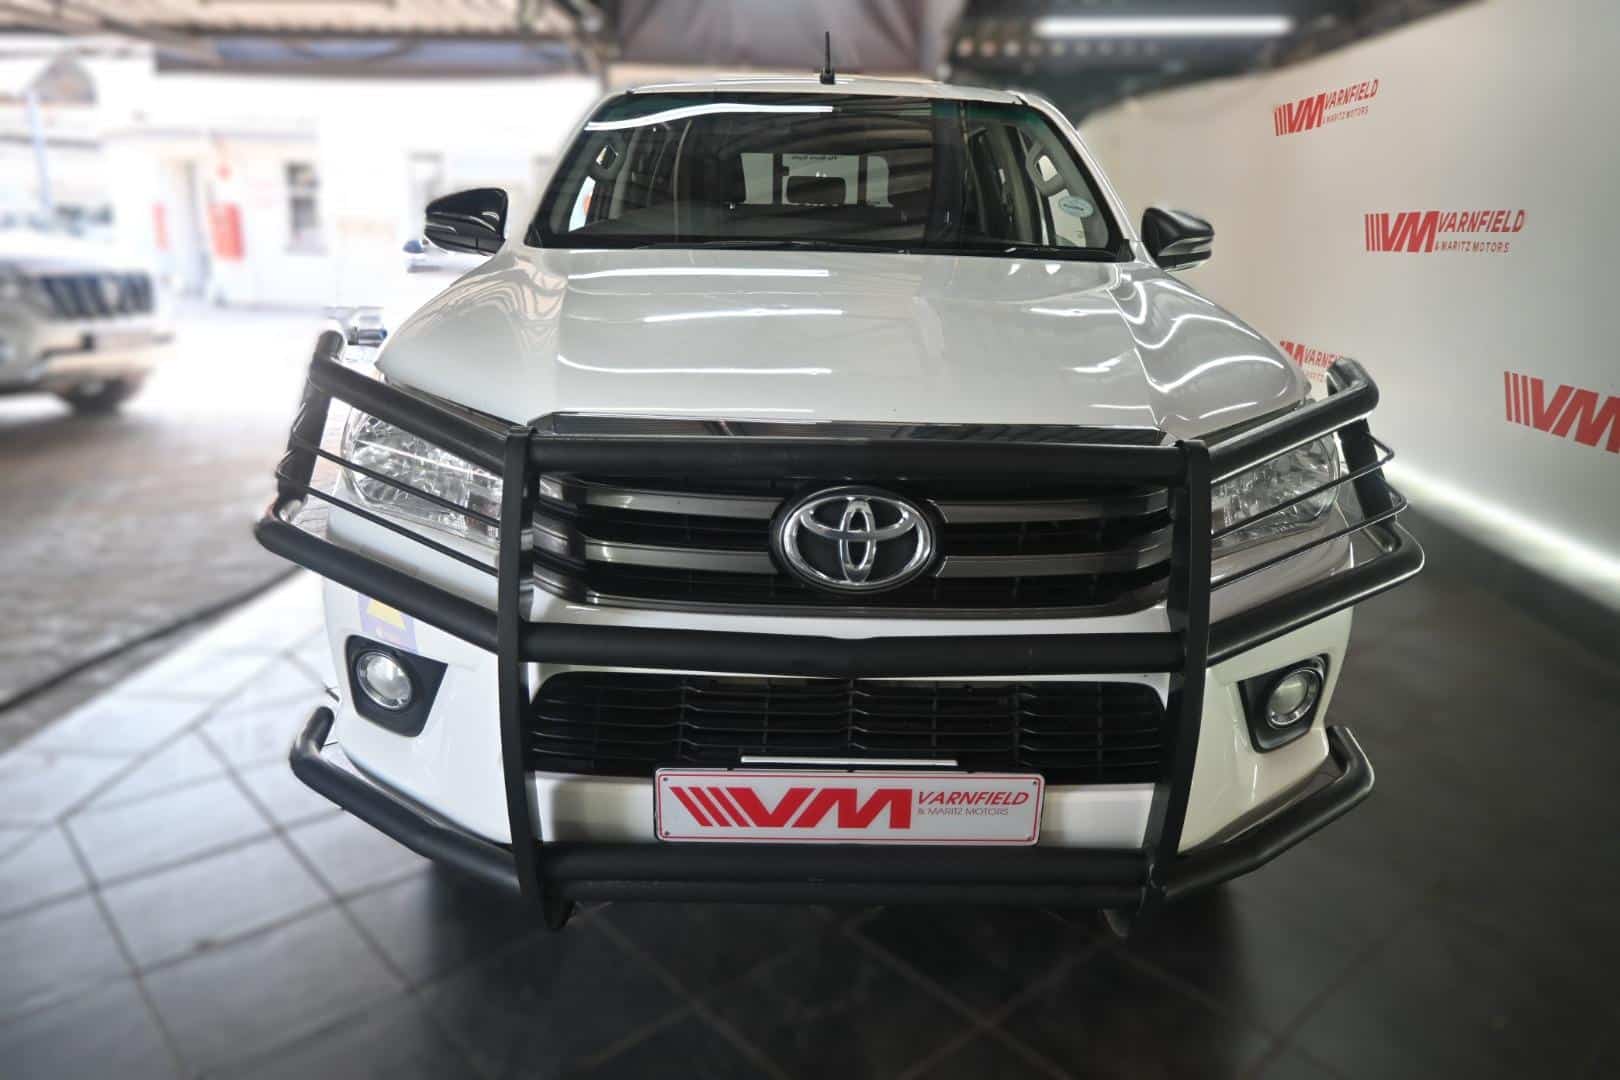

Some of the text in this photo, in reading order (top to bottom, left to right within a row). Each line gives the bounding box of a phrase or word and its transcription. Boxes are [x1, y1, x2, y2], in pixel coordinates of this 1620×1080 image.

[1324, 79, 1379, 110] VARNFIELD
[1287, 93, 1326, 133] VM
[1381, 211, 1440, 254] VM
[1438, 209, 1525, 233] VARNFIELD
[1473, 242, 1511, 253] MOTORS
[1530, 377, 1620, 454] VM
[726, 787, 913, 829] VM
[918, 791, 1029, 806] VARNFIELD
[927, 807, 964, 817] MARITZ
[965, 807, 1009, 817] MOTORS
